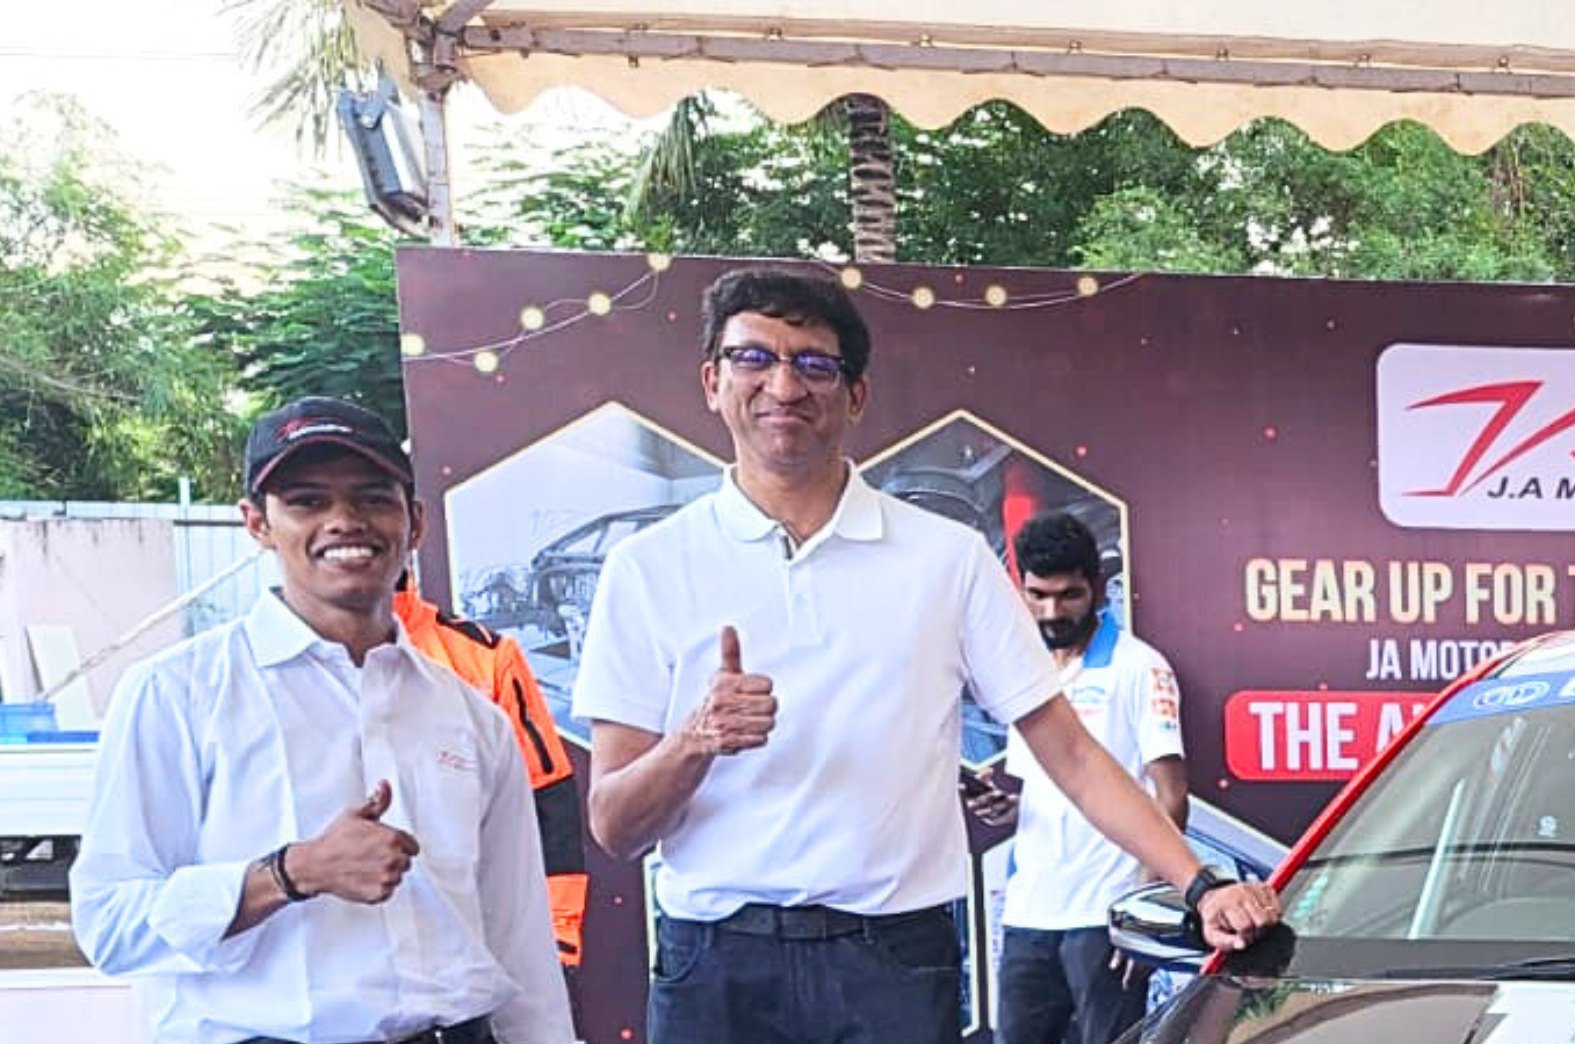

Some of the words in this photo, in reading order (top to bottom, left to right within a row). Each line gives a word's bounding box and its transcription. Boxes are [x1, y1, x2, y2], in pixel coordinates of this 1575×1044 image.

[1487, 476, 1543, 499] J.A
[1245, 559, 1376, 622] GEAR
[1389, 561, 1453, 624] UP
[1466, 564, 1556, 625] FOR
[1366, 639, 1402, 680] JA
[1410, 640, 1516, 680] MOTO
[1249, 702, 1359, 770] THE
